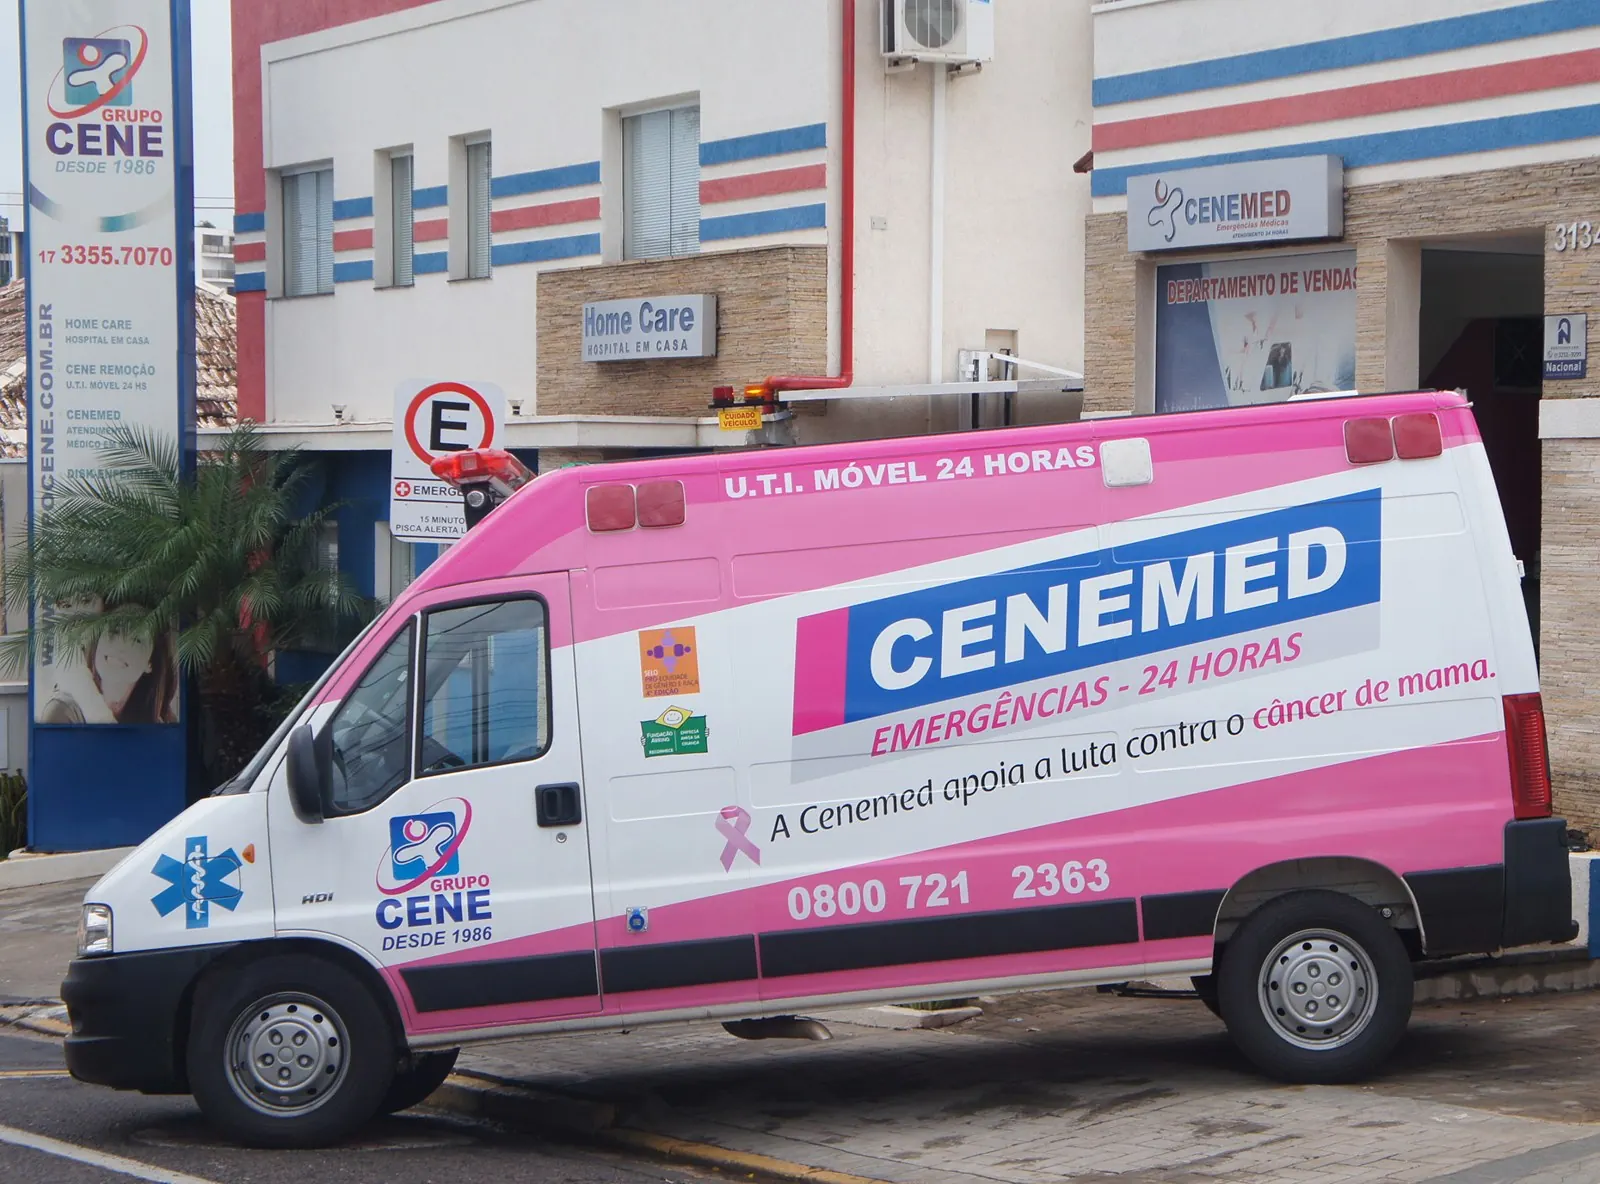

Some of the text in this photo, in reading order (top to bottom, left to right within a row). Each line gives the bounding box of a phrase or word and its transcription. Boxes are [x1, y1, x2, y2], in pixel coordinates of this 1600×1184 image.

[102, 108, 163, 123] GRUPO
[46, 122, 163, 157] CENE
[55, 159, 155, 175] DESDE 1986
[1185, 190, 1291, 225] CENEMED
[38, 245, 173, 266] 17 3355.7070
[1167, 273, 1276, 304] DEPARTAMENTO
[1280, 271, 1299, 294] DE
[65, 319, 132, 330] HOME CARE
[585, 301, 695, 337] Home Care
[65, 335, 150, 345] HOSPITAL EM CASA
[587, 338, 688, 356] HOSPITAL EM CASA
[66, 363, 156, 377] CENE REMOÇÃO
[1546, 361, 1582, 373] Nacional
[66, 380, 147, 390] U.T.I. MÓVEL 24 HS
[66, 409, 121, 420] CENEMED
[724, 411, 756, 420] CUIDADO
[430, 400, 470, 452] E
[66, 438, 101, 448] MÉDICO
[724, 444, 1097, 499] U.T.I. MÓVEL 24 HORAS
[420, 515, 465, 525] 15 MINUTO
[395, 524, 422, 532] PISCA
[424, 525, 458, 534] ALERTA
[869, 526, 1348, 691] CENEMED
[644, 669, 659, 677] SELO
[654, 687, 680, 697] EDIÇÃO
[871, 676, 1110, 758] EMERGÊNCIAS
[1138, 658, 1178, 696] 24
[1187, 631, 1302, 685] HORAS
[770, 658, 1497, 842] A Cenemed apoia a luta contra o câncer de mama.
[430, 874, 490, 892] GRUPO
[787, 858, 1111, 921] 0800 721 2363
[301, 892, 335, 905] HDI
[375, 889, 492, 930] CENE
[382, 926, 492, 951] DESDE 1986
